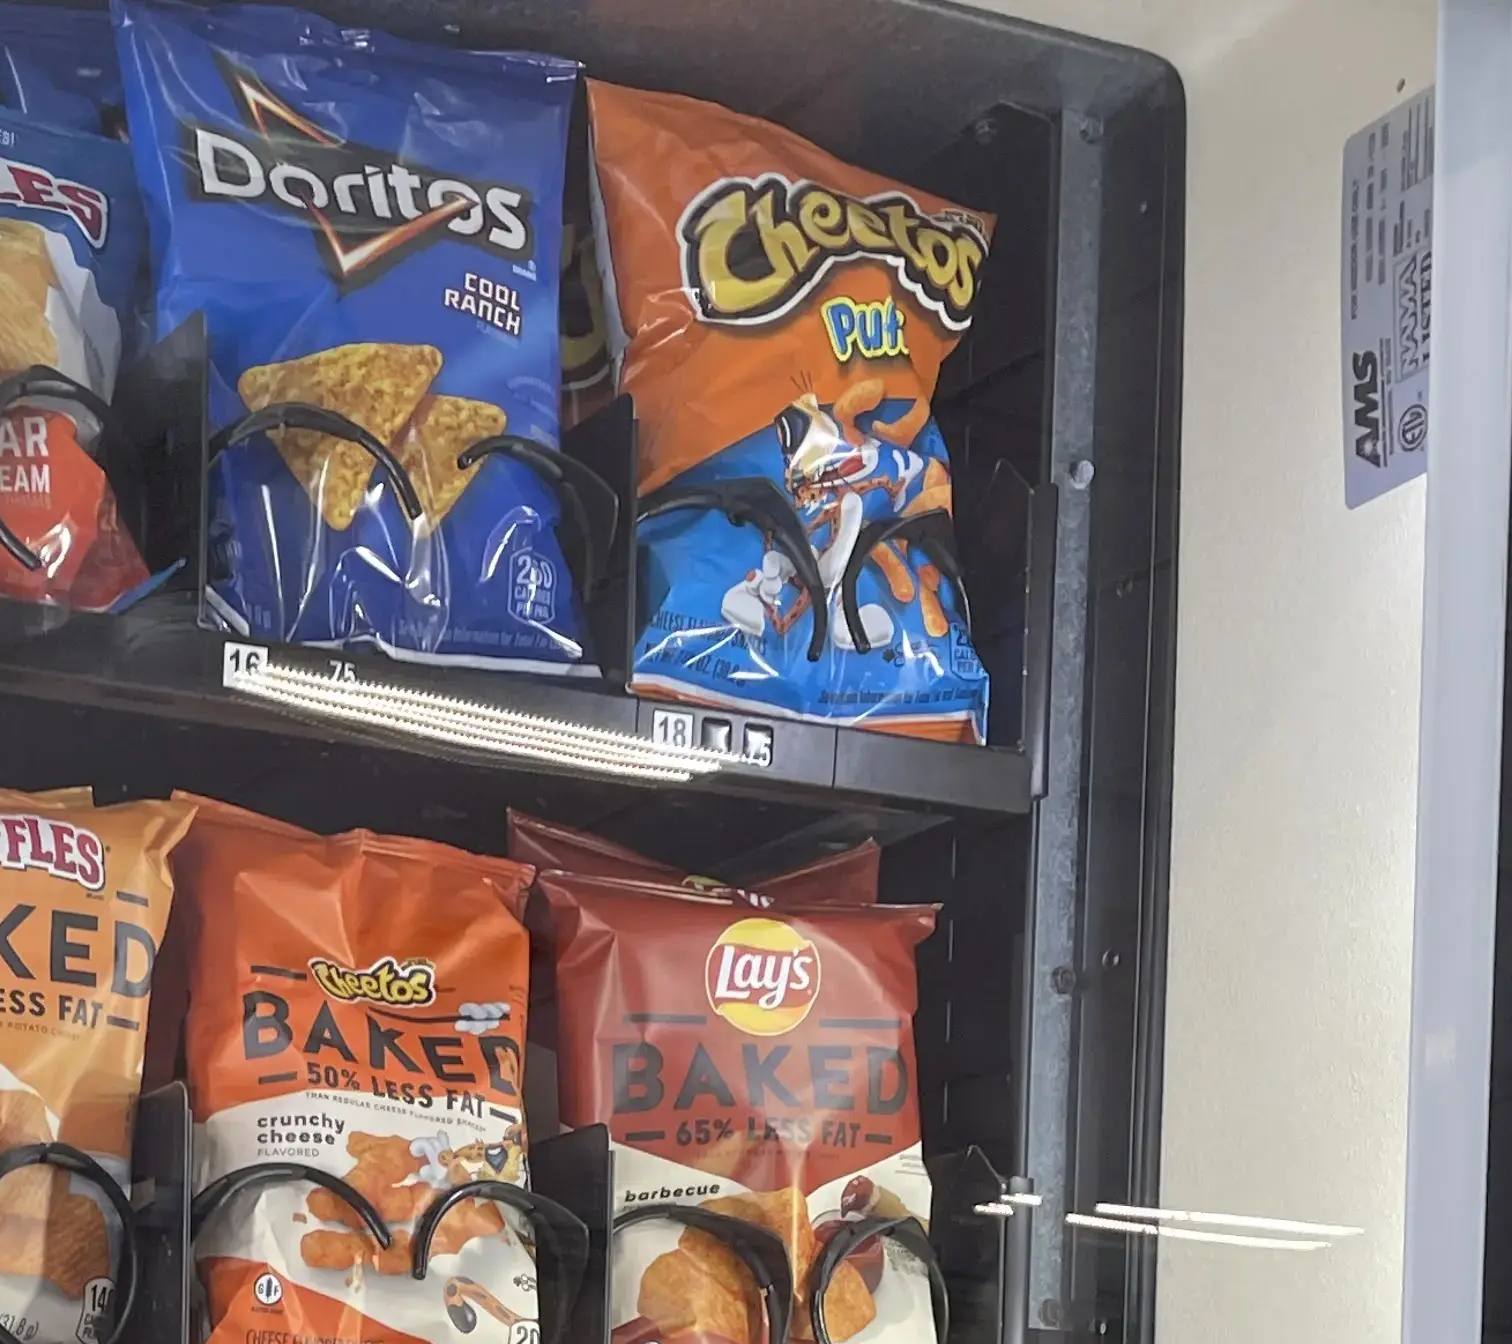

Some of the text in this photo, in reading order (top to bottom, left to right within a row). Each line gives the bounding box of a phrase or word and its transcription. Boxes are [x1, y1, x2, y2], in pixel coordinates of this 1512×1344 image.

[195, 128, 527, 251] Doritos
[687, 185, 985, 314] Cheetos
[443, 288, 521, 337] RANCH
[465, 272, 520, 312] COOL
[1353, 350, 1381, 468] AMS
[229, 647, 264, 678] 16
[658, 716, 686, 746] 18
[312, 962, 431, 1003] Cheetos
[715, 946, 810, 1009] Lay's
[59, 996, 103, 1028] FAT
[243, 991, 520, 1096] BAKED
[308, 1062, 484, 1118] 50% LESS FAT
[612, 1042, 909, 1114] BAKED
[257, 1113, 345, 1134] crunchy
[257, 1130, 335, 1145] cheese
[677, 1117, 861, 1147] 65% LESS FAT
[624, 1182, 720, 1203] barbecue
